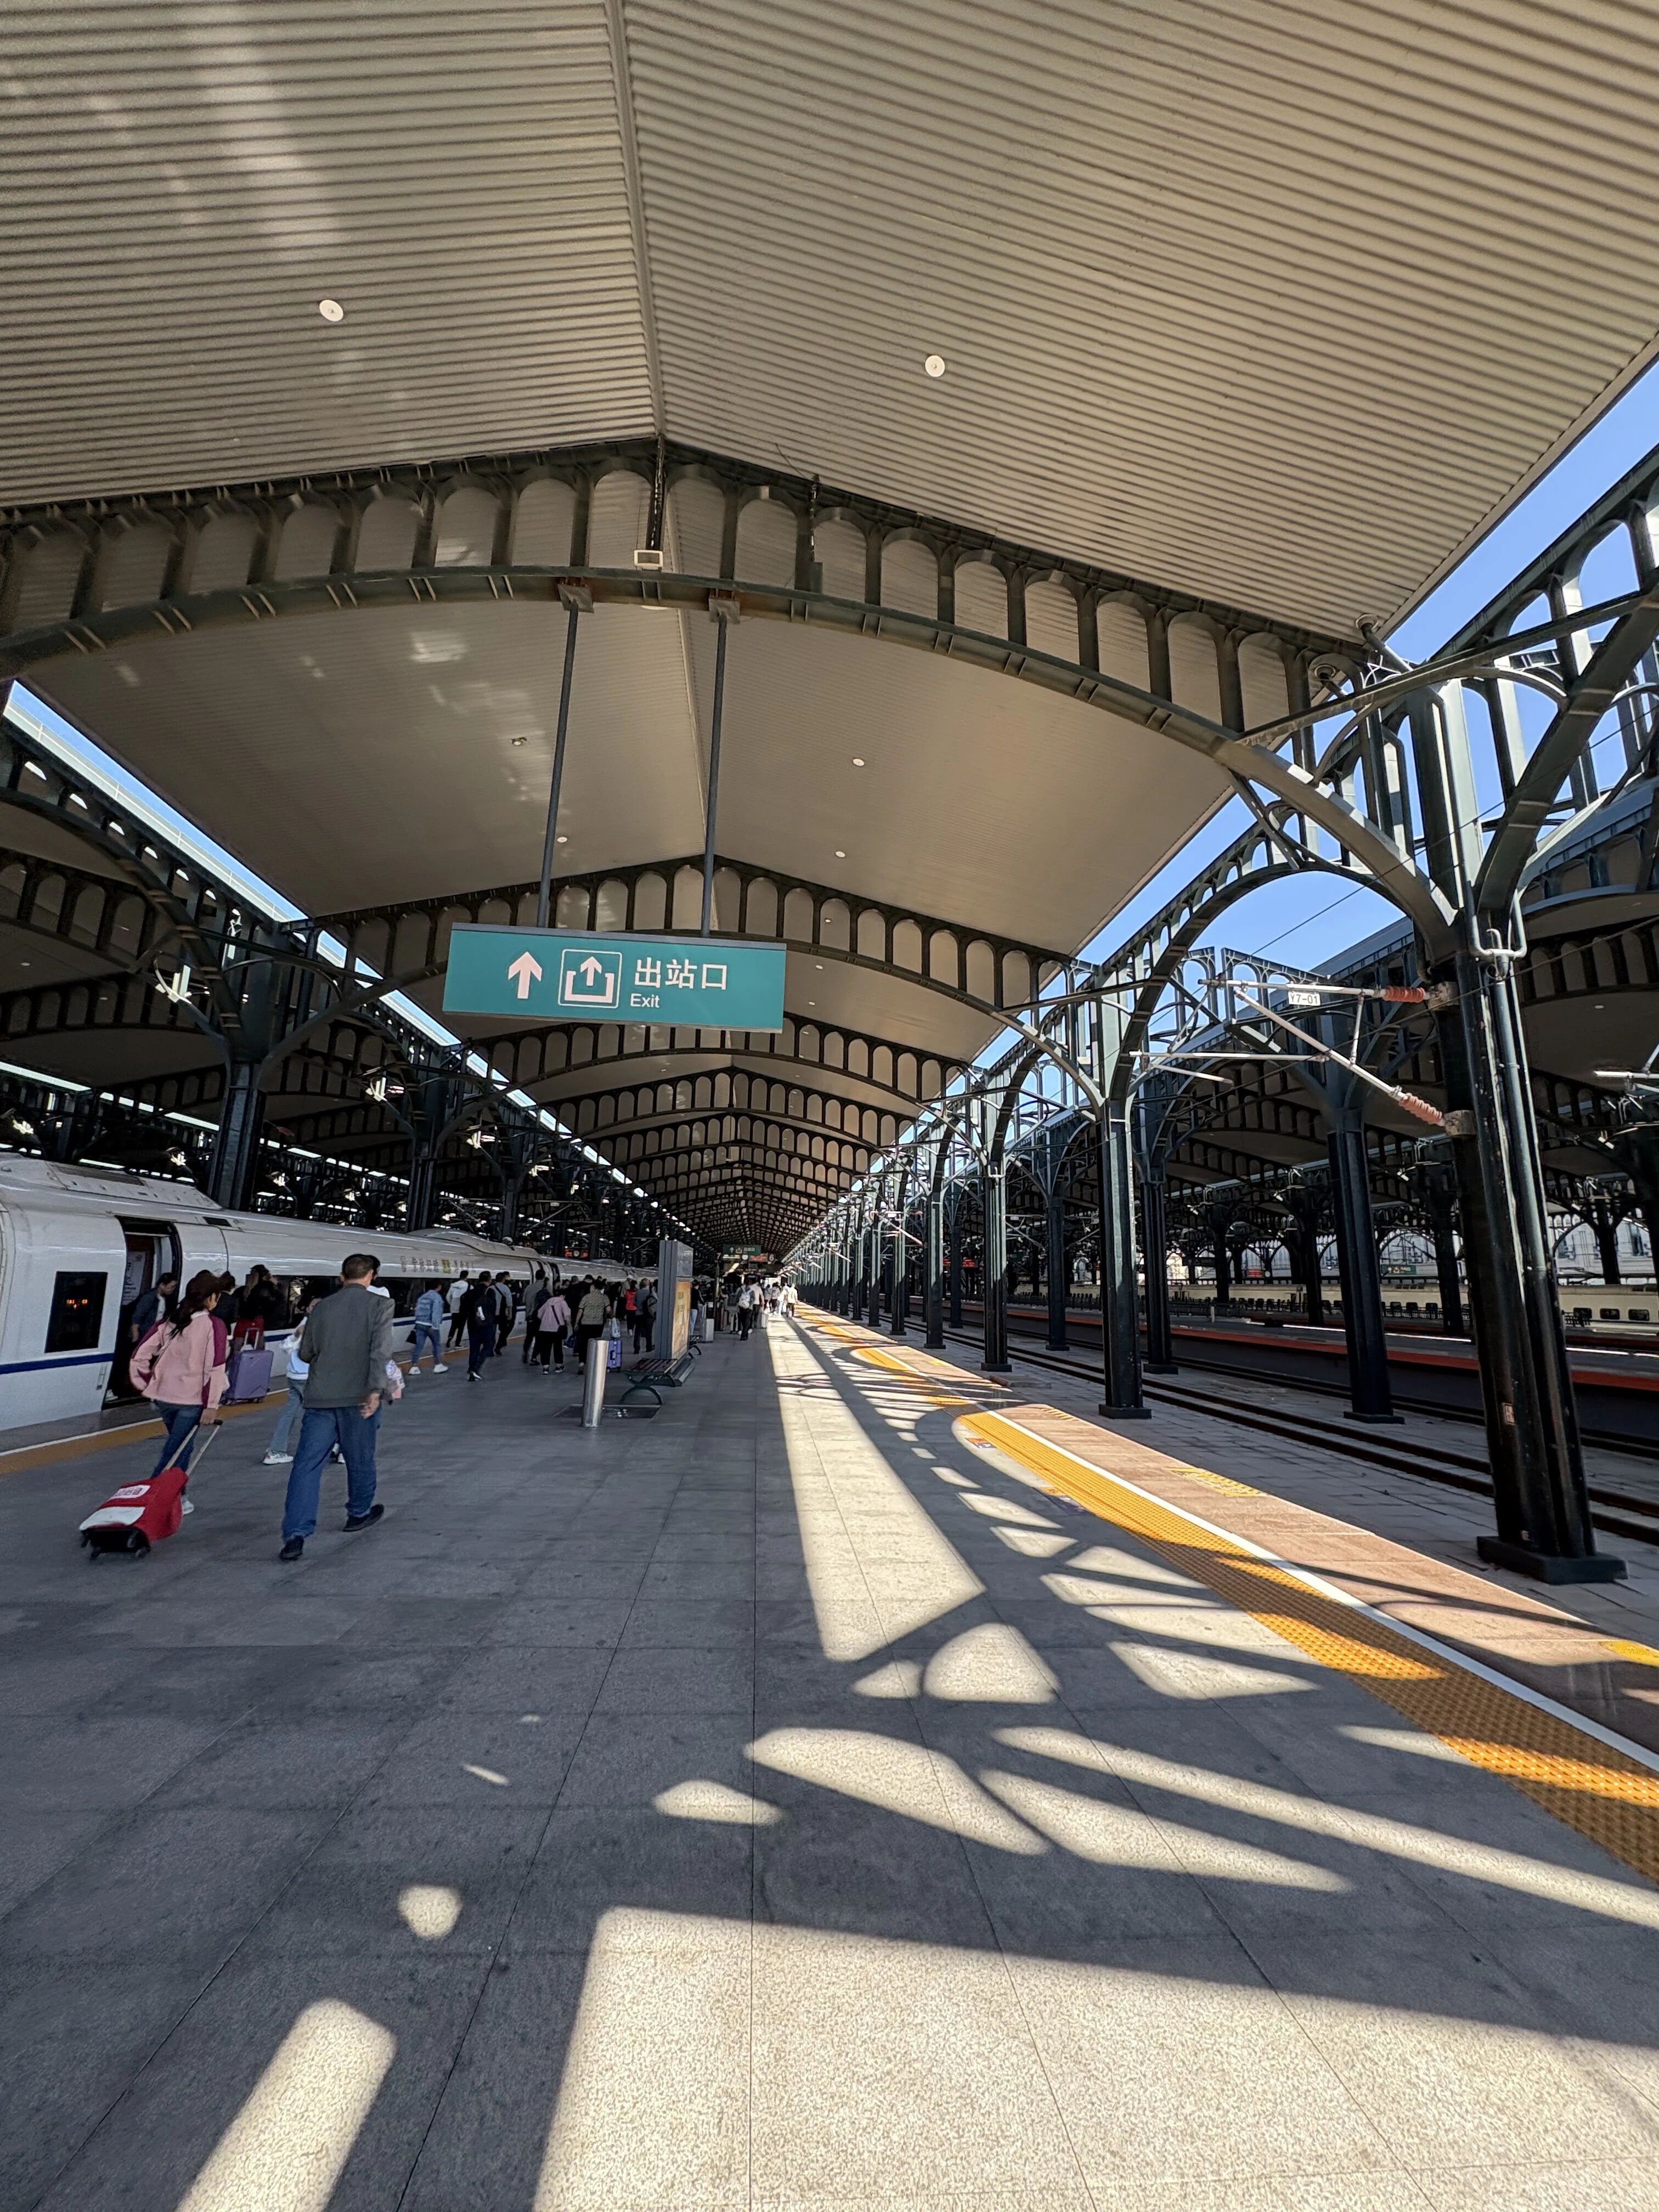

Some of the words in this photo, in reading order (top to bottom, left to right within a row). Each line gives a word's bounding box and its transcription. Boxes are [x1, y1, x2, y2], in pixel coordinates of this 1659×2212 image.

[634, 957, 727, 990] 出站口
[630, 993, 660, 1008] Exit
[1290, 993, 1318, 1005] Y7-01
